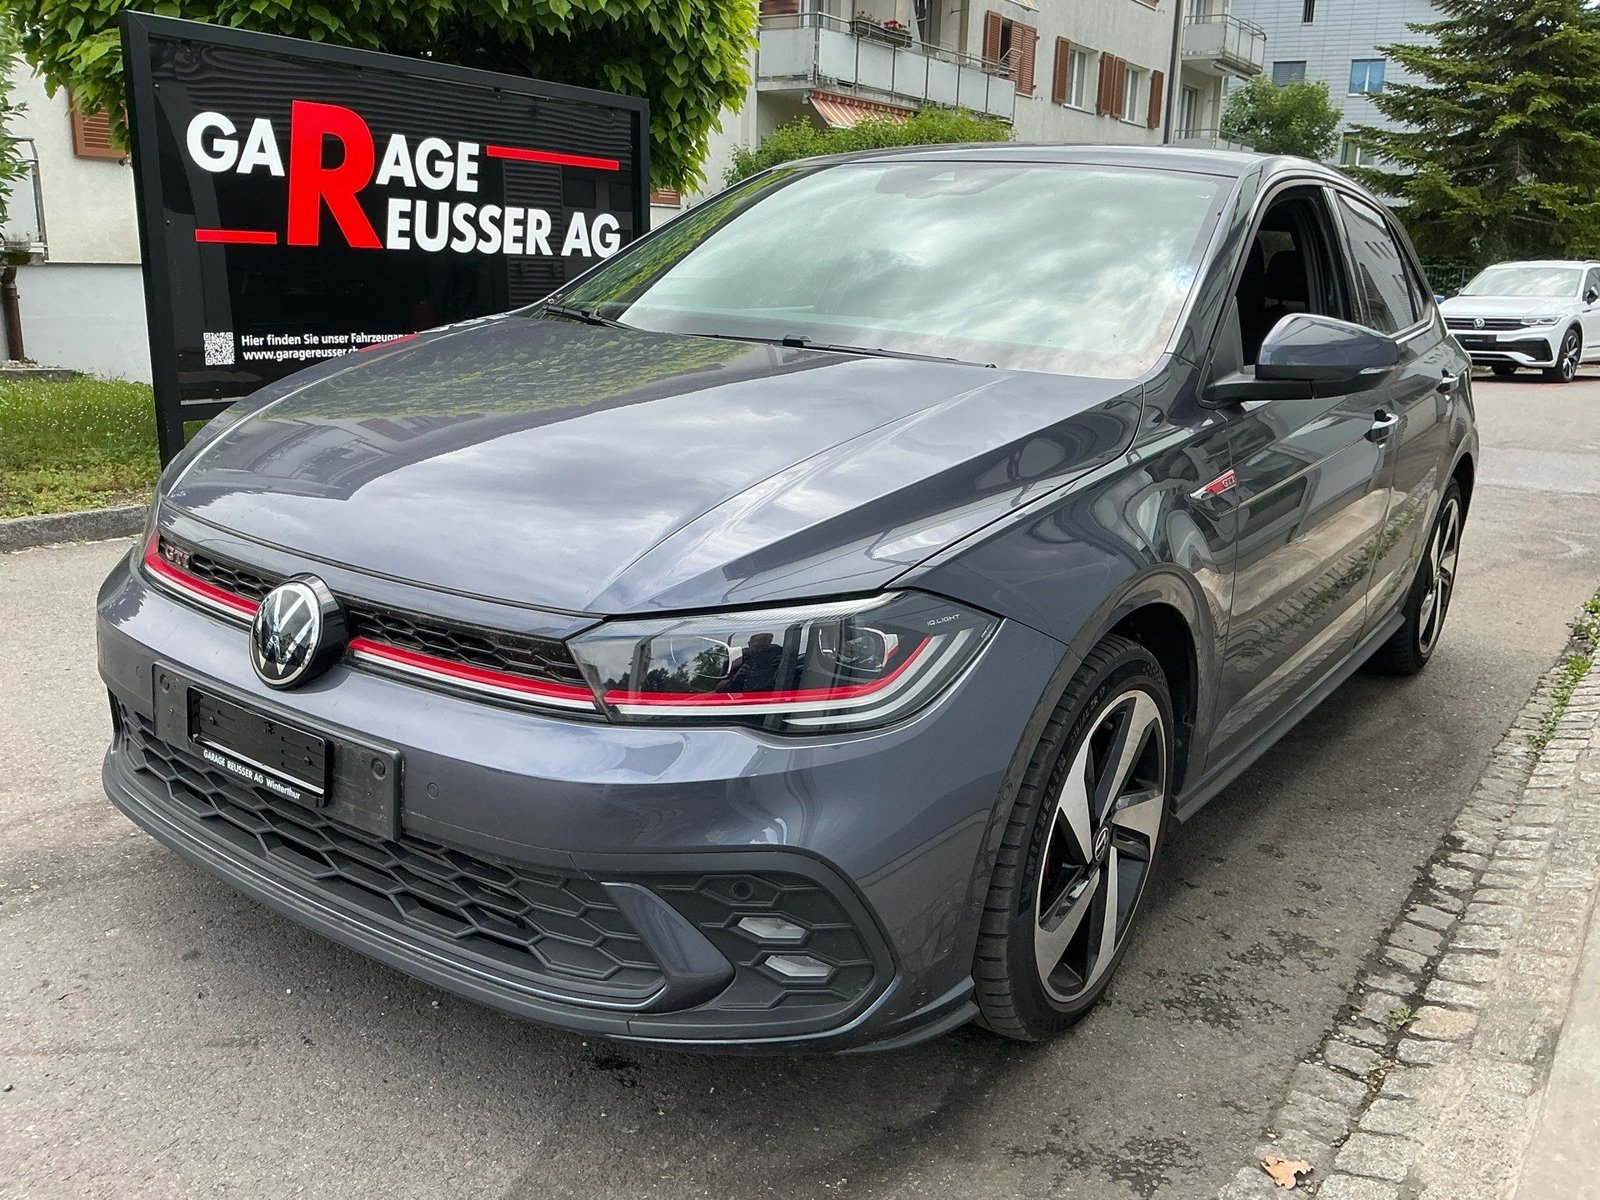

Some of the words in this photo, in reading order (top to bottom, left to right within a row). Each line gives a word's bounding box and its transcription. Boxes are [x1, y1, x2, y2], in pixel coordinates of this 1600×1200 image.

[186, 100, 480, 249] GARAGE
[561, 207, 621, 259] AG
[241, 335, 265, 346] Hier
[267, 334, 301, 346] finden
[303, 334, 320, 345] Sie
[322, 334, 349, 344] unser
[165, 545, 190, 569] GTI
[203, 749, 225, 767] GARAGE
[227, 761, 252, 779] REUSSER
[253, 773, 264, 784] AG
[266, 778, 300, 800] Winterthur
